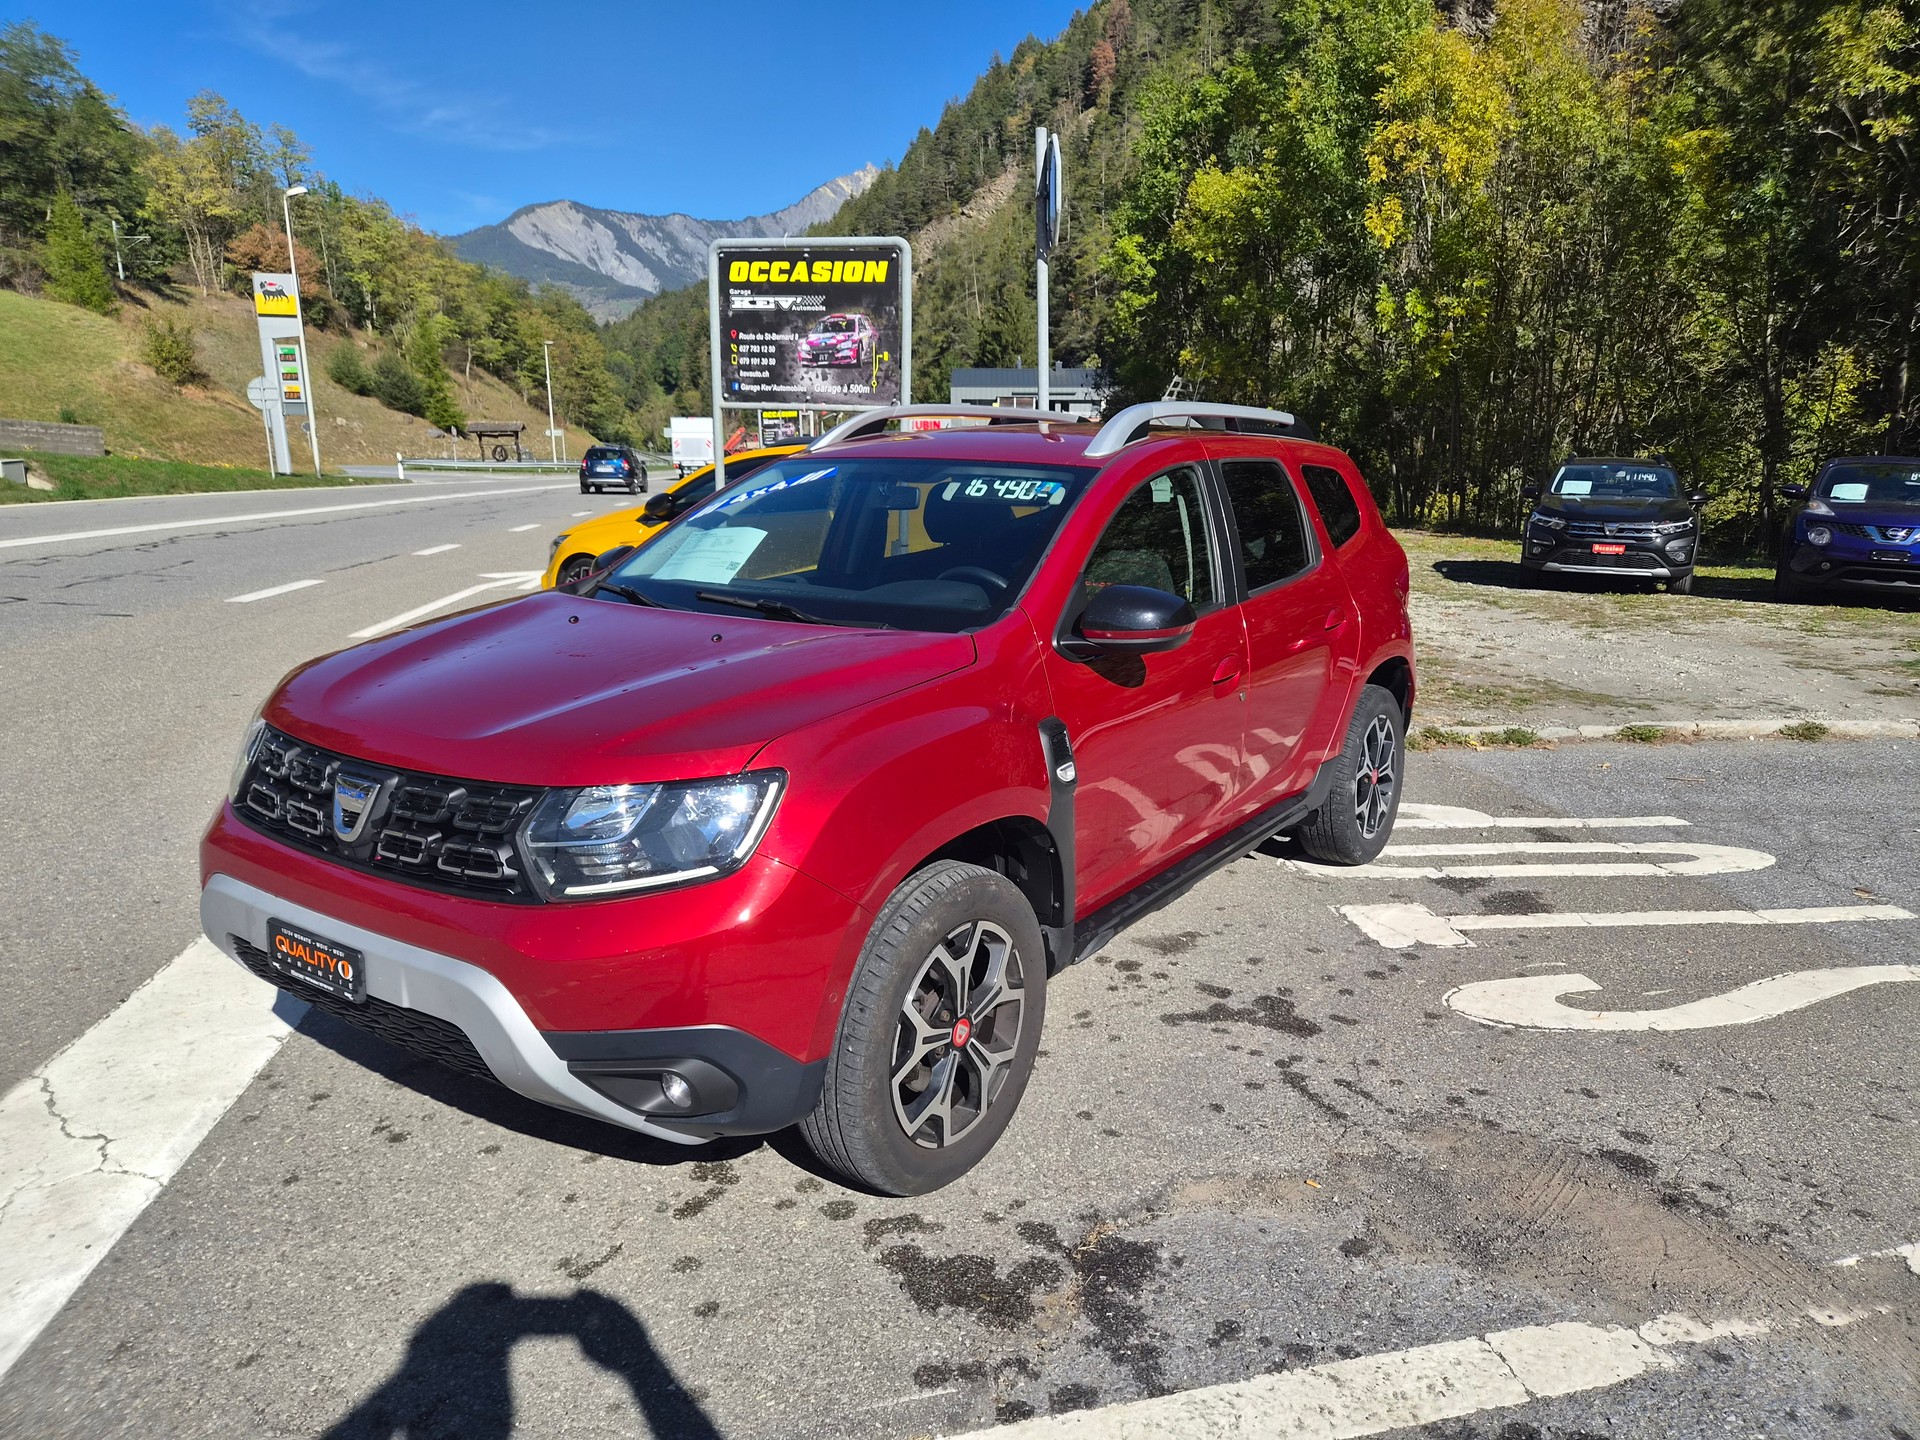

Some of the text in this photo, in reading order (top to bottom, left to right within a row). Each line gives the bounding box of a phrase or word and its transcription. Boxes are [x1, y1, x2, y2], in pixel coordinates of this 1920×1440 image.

[729, 261, 888, 283] OCCASION
[739, 332, 755, 340] Route
[764, 332, 794, 340] St-Bernard
[740, 383, 760, 392] Garage
[814, 384, 870, 394] Garage à 500m
